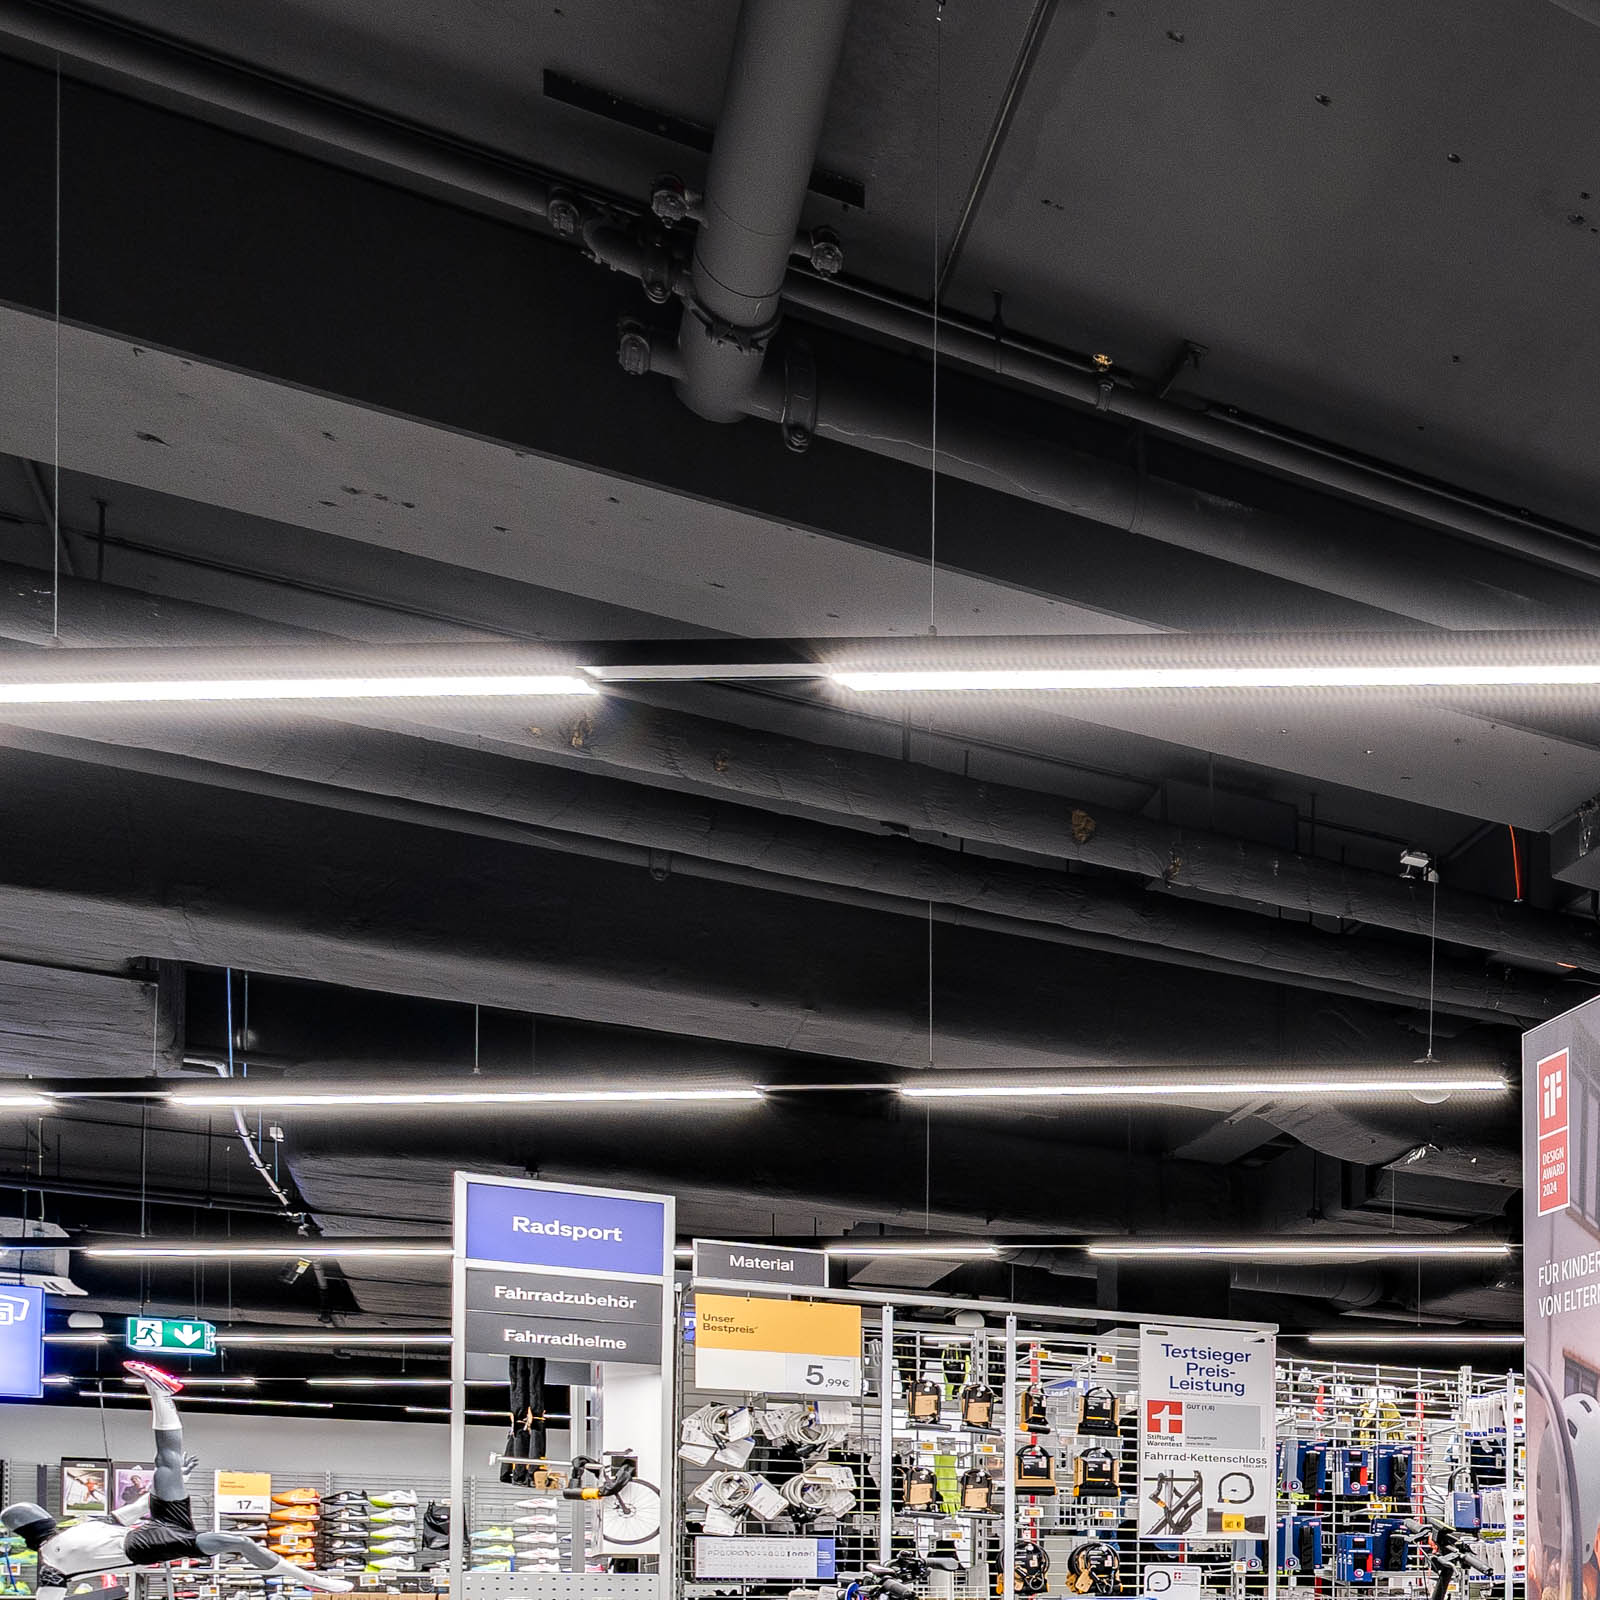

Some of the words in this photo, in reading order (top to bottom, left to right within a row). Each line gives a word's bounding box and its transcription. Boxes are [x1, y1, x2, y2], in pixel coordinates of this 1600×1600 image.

[1543, 1147, 1564, 1165] DESIGN
[1543, 1162, 1565, 1181] AWARD
[1543, 1182, 1557, 1197] 2024
[512, 1215, 623, 1242] Radsport
[729, 1254, 794, 1272] Material
[1538, 1260, 1560, 1287] FÜR
[494, 1285, 637, 1309] Fahrradzubehör
[1538, 1295, 1561, 1318] VON
[702, 1313, 735, 1323] Unser
[503, 1328, 627, 1350] Fahrradhelme
[1161, 1343, 1251, 1364] Testsieger
[805, 1364, 850, 1388] 5,99€
[1186, 1362, 1236, 1378] Preis-
[1169, 1375, 1245, 1396] Leistung
[1147, 1433, 1175, 1441] Stiftung
[1147, 1440, 1182, 1448] Warentest
[1144, 1452, 1267, 1465] Fahrrad-Kettenschloss
